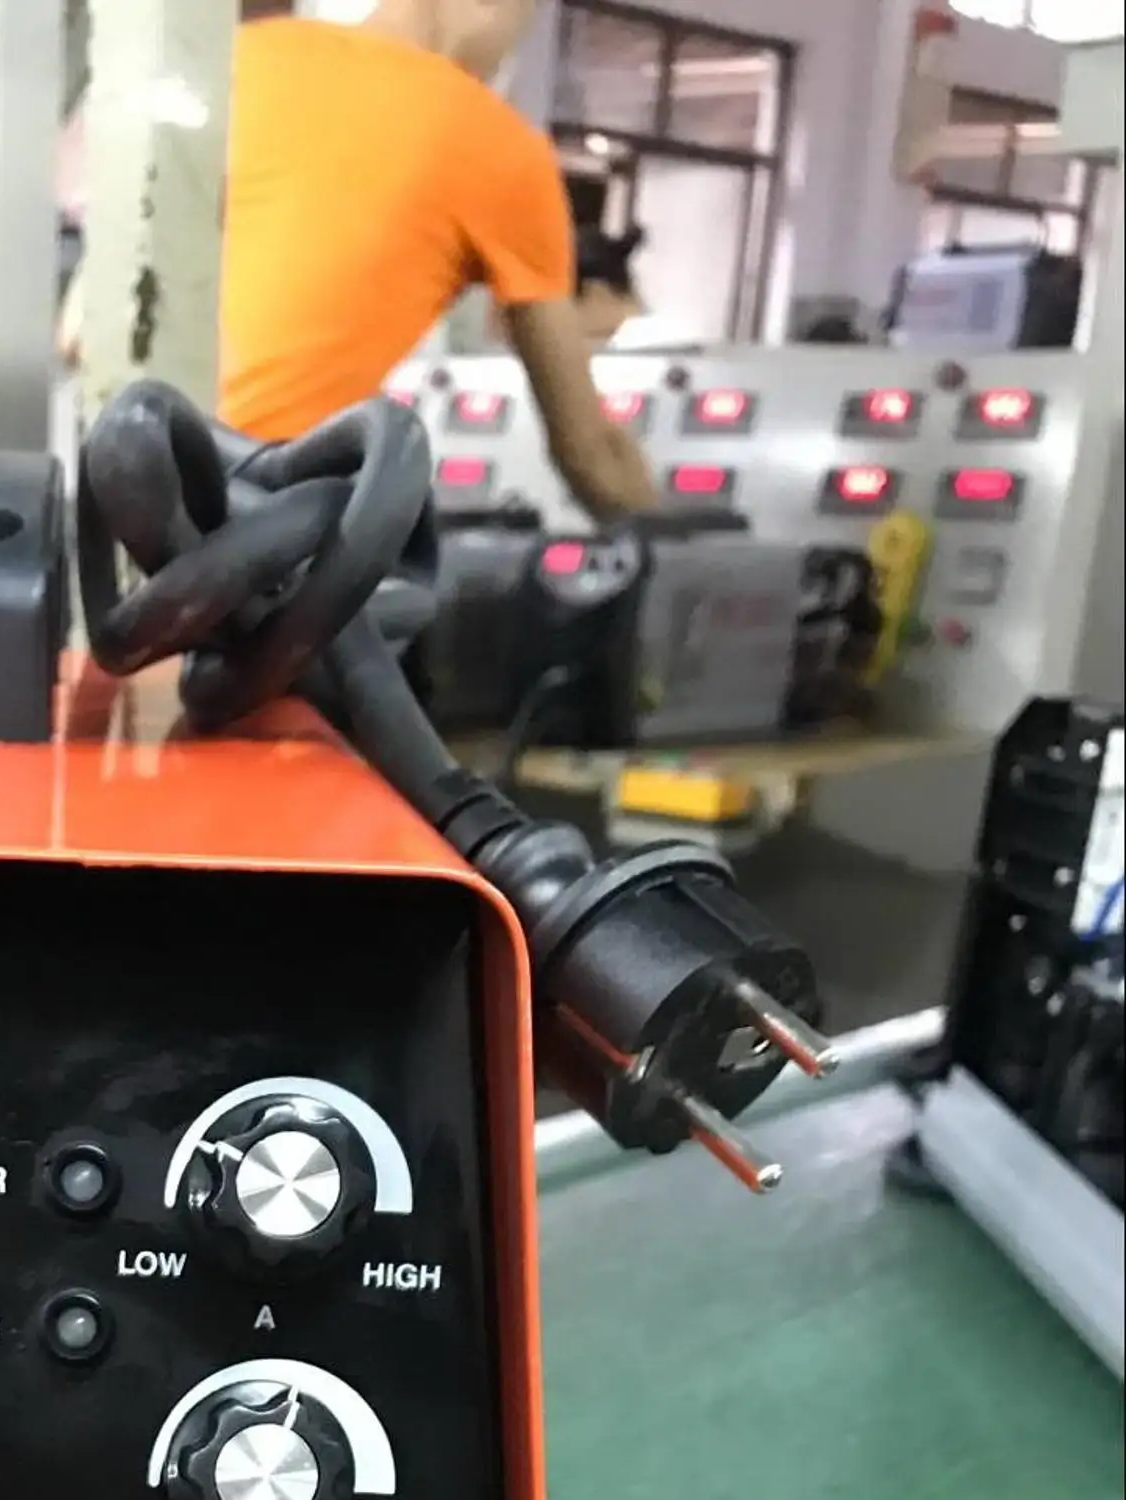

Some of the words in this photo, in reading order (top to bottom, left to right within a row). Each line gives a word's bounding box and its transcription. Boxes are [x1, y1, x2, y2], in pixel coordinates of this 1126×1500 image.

[118, 1249, 187, 1278] LOW
[362, 1262, 442, 1291] HIGH
[254, 1305, 276, 1329] A
